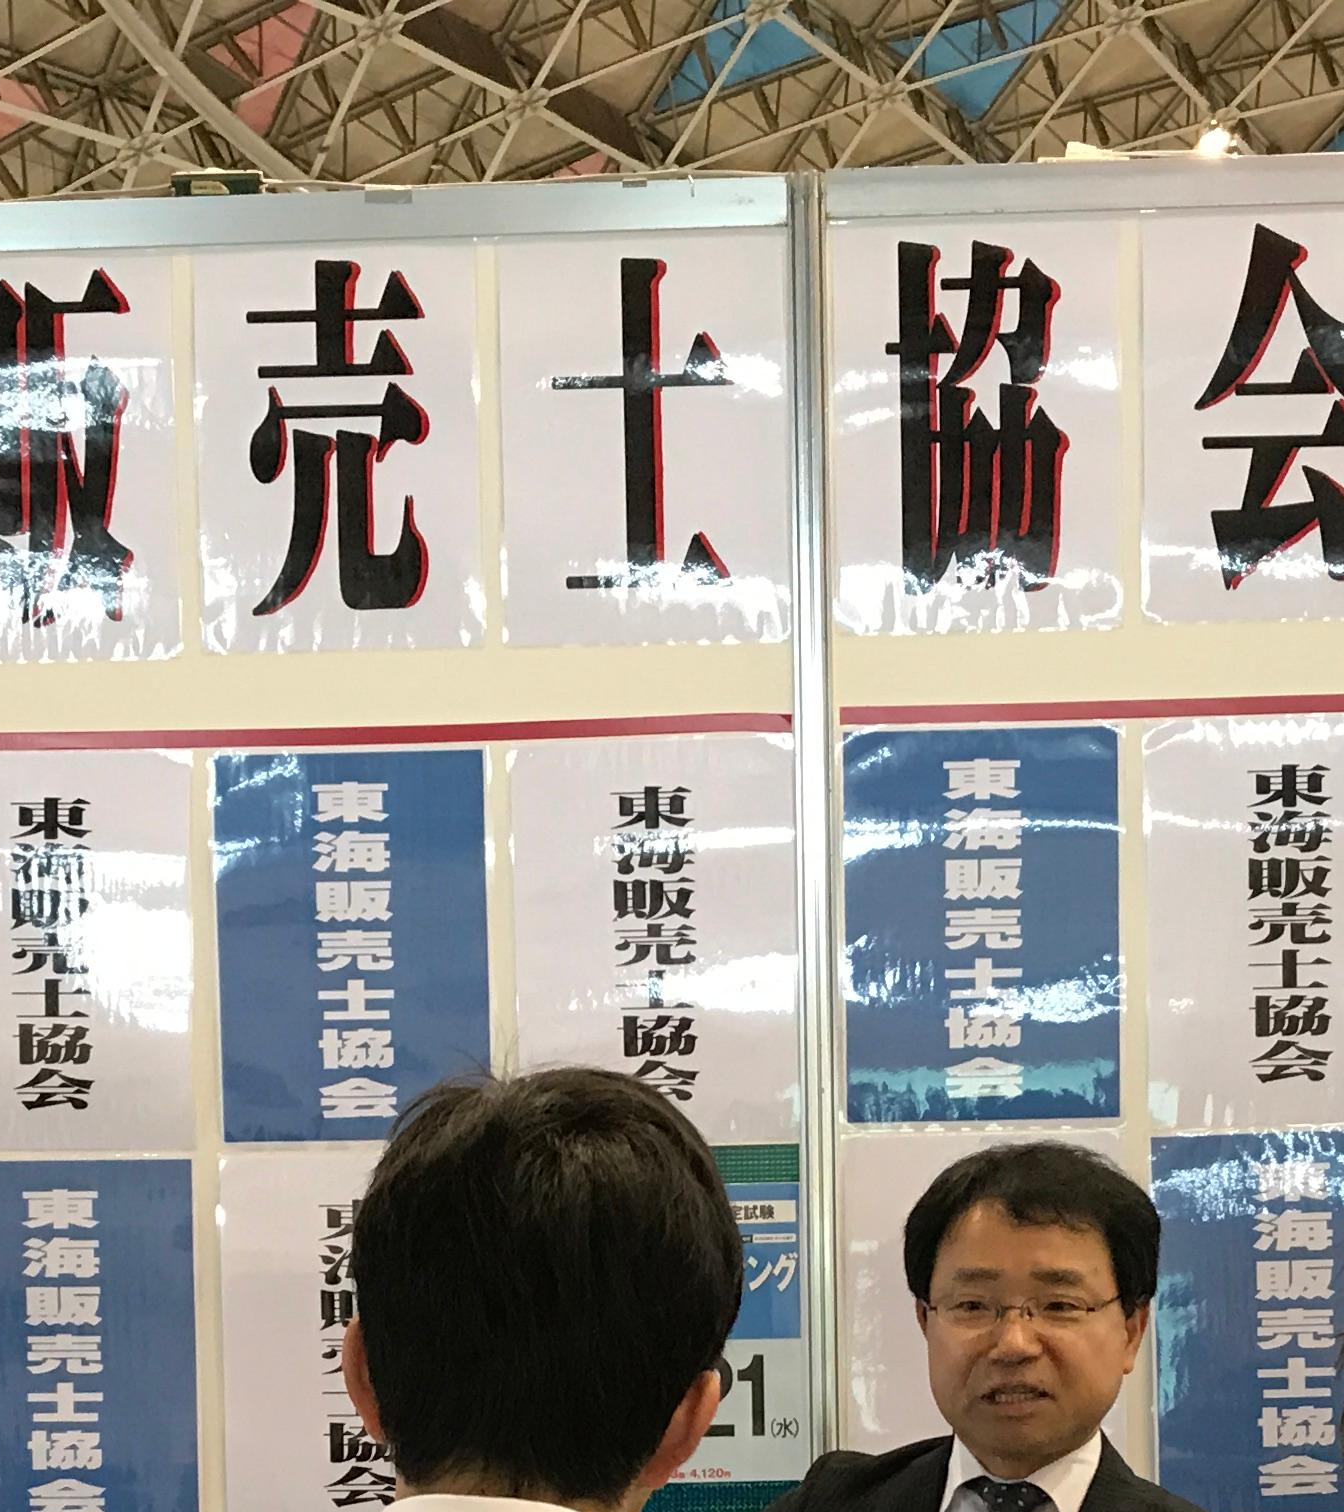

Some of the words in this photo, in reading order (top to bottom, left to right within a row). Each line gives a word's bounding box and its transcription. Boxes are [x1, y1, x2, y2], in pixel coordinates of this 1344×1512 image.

[311, 780, 399, 1121] 東海販売士協会
[941, 758, 1025, 1101] 東海販売士協会
[1247, 763, 1334, 1084] 東海販売士協会
[1252, 1161, 1340, 1497] 東海販売士協会
